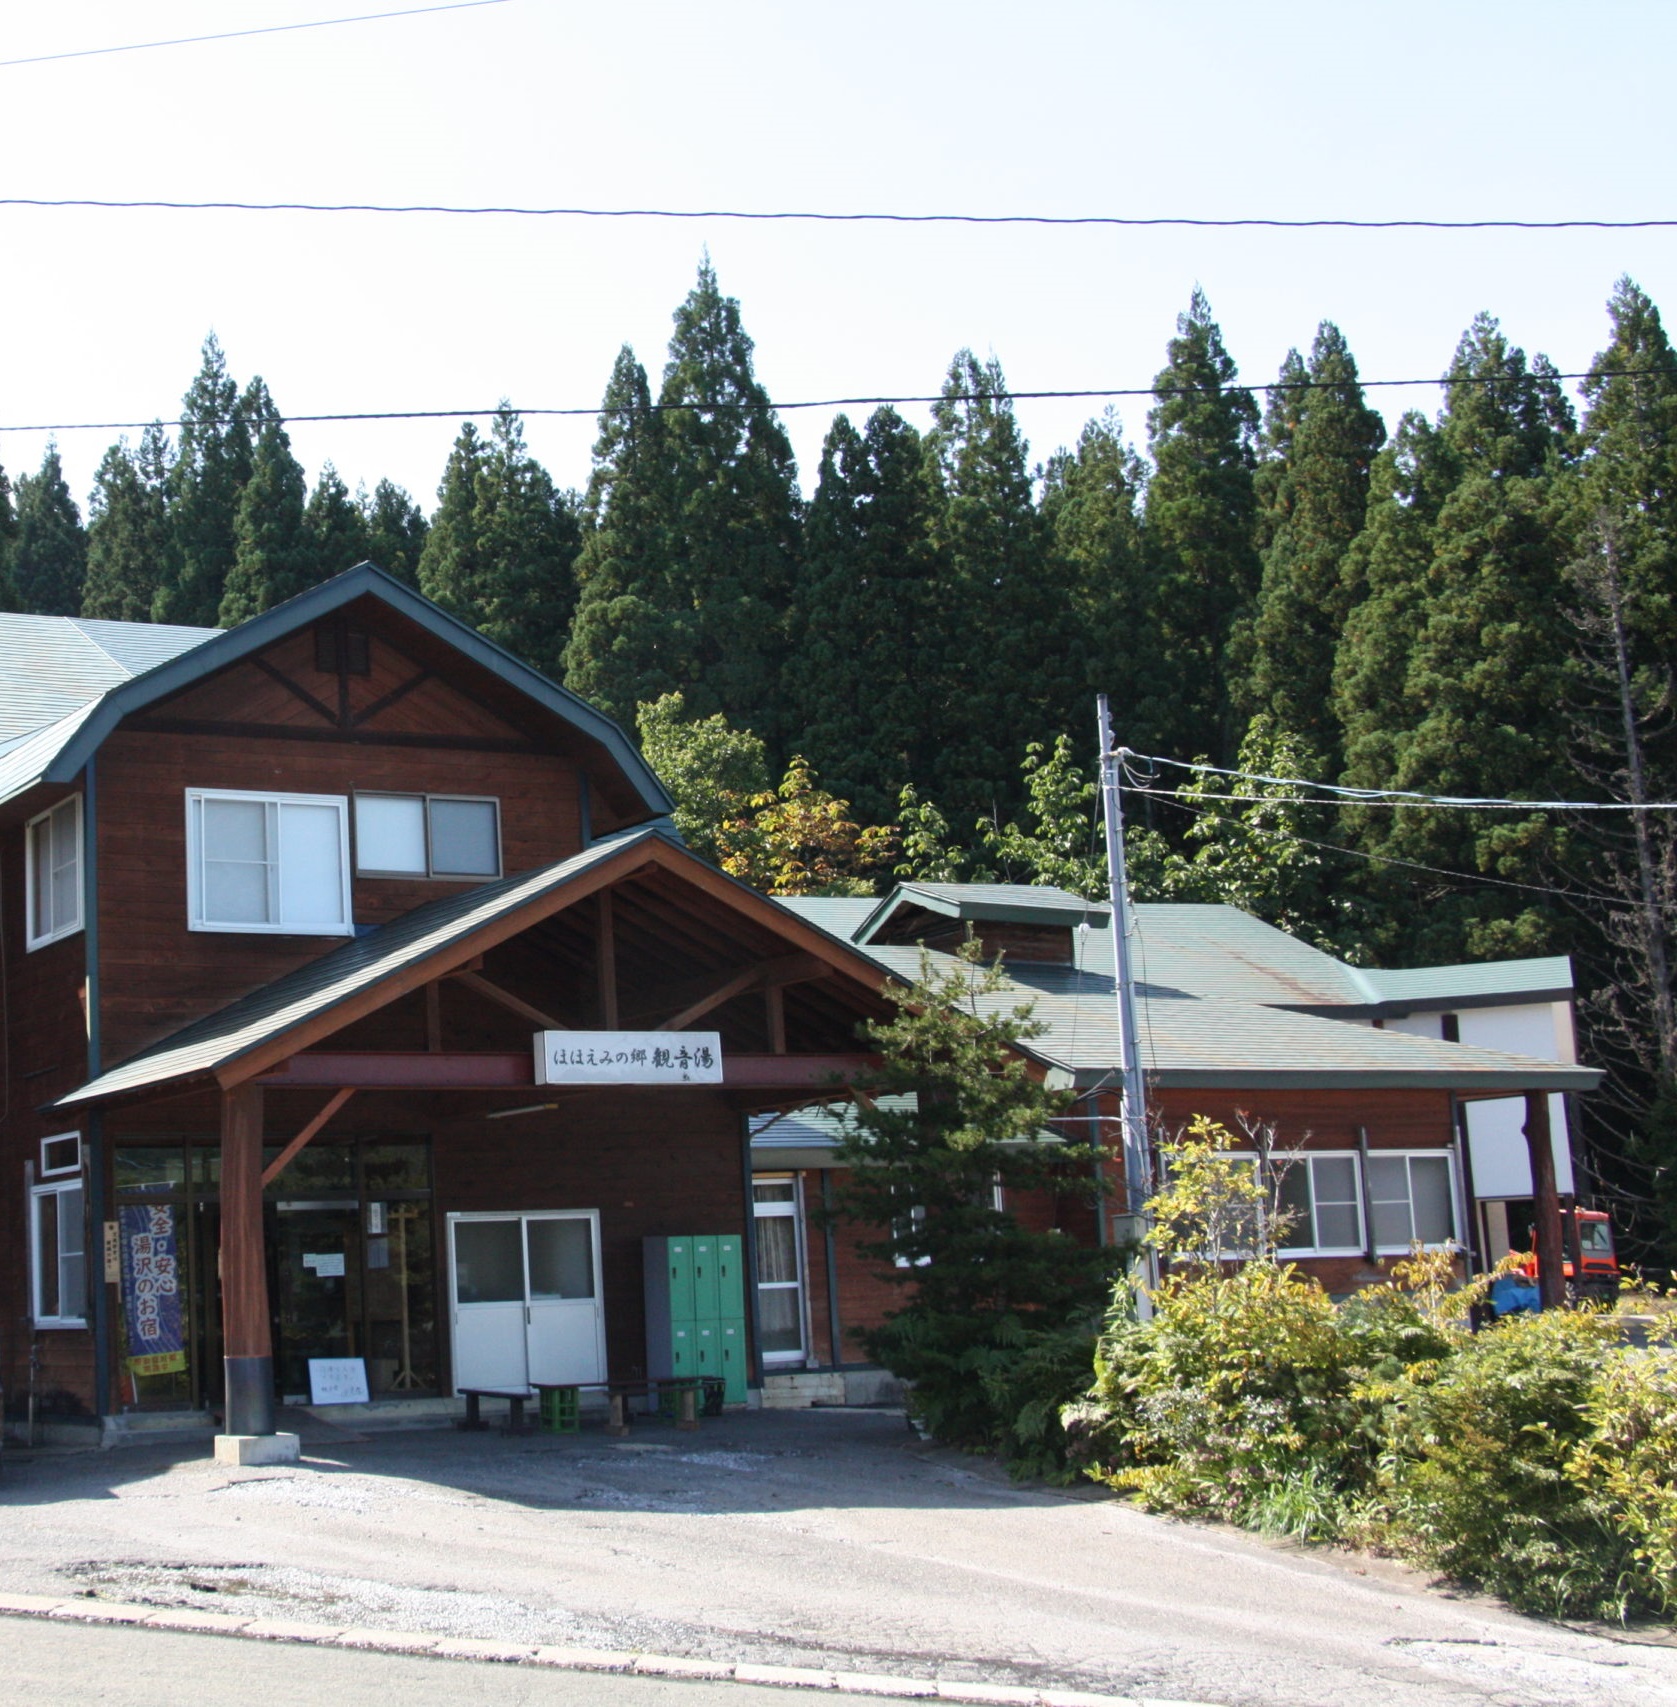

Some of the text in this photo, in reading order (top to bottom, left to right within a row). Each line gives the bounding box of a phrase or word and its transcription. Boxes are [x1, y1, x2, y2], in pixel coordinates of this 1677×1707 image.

[553, 1045, 714, 1070] ほほえみの郷 観音湯
[134, 1235, 159, 1338] 湯沢のお宿
